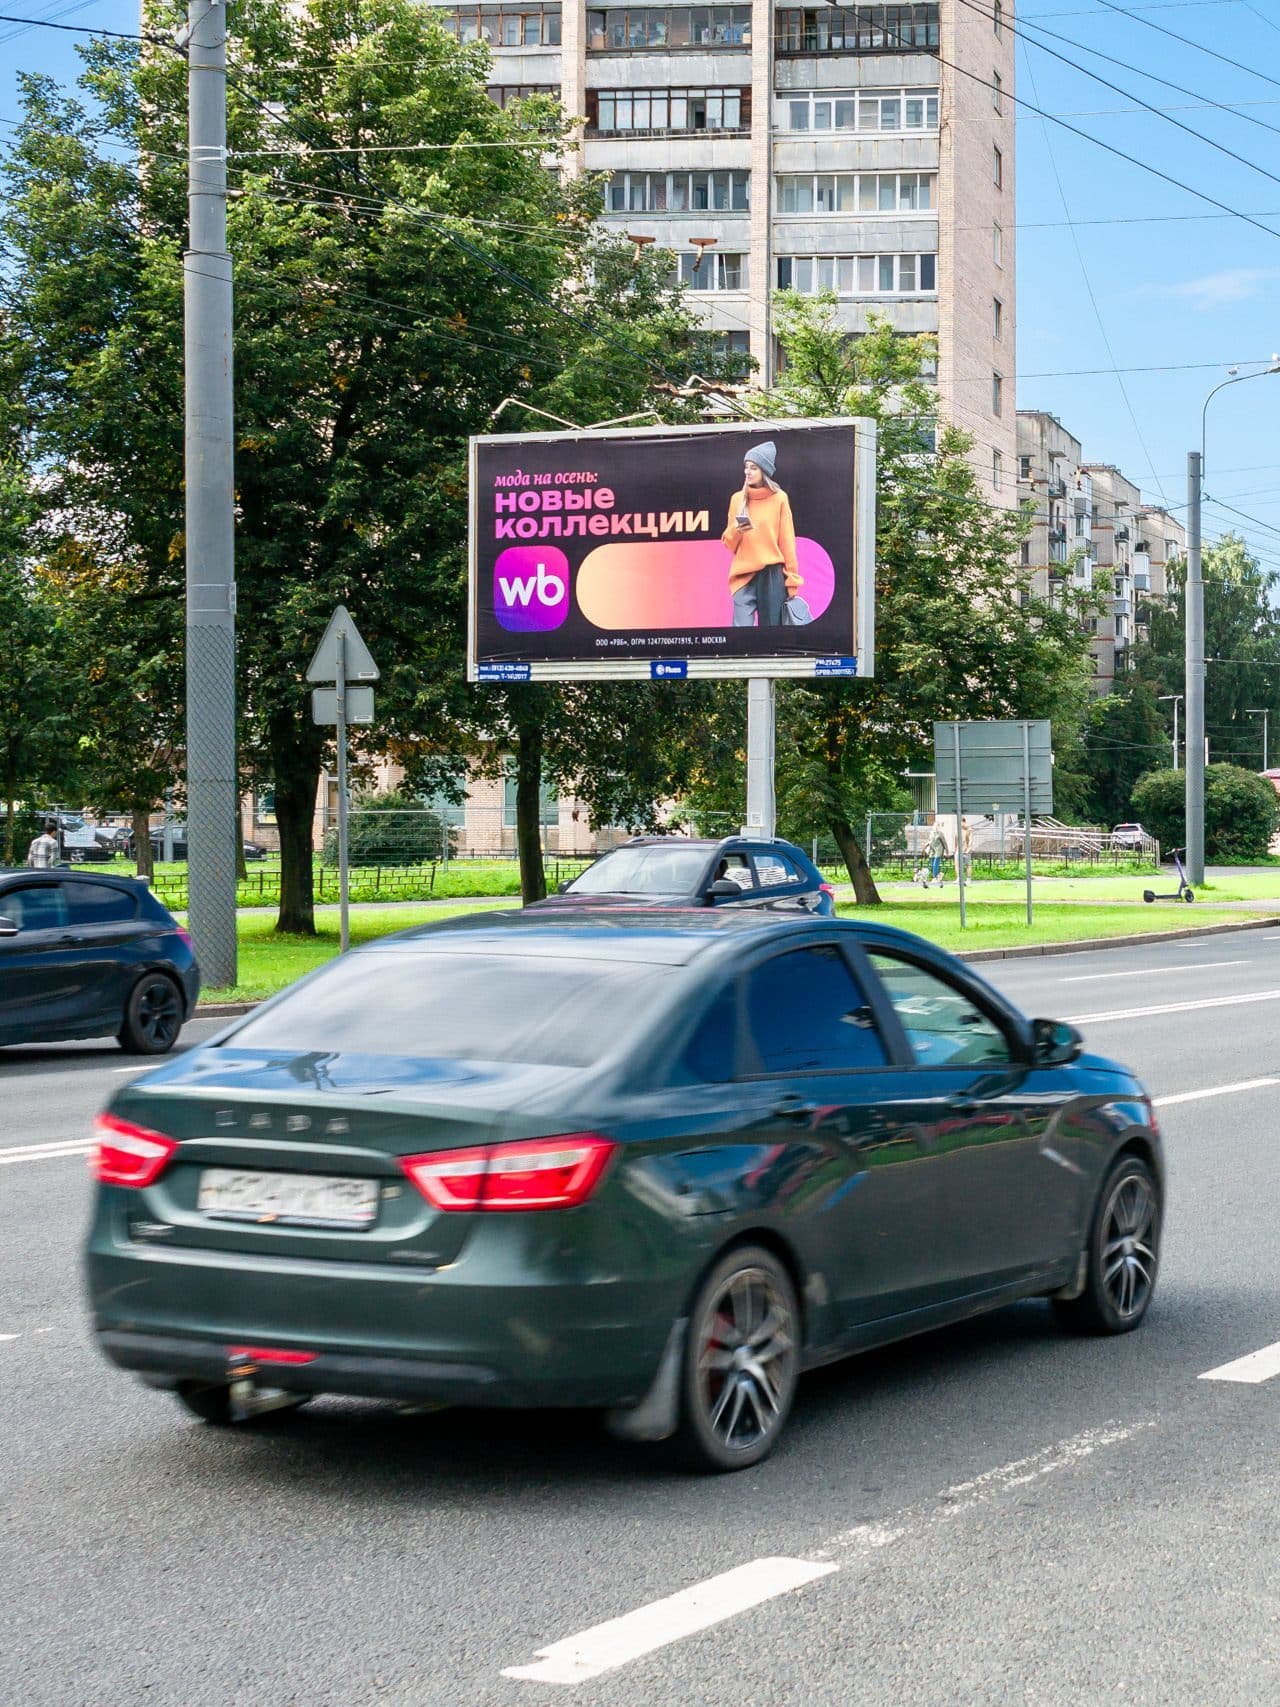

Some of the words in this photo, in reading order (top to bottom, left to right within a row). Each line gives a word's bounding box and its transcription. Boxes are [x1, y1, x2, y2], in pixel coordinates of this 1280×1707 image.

[494, 469, 531, 487] мода
[533, 474, 552, 486] на
[554, 471, 599, 485] осень:
[494, 487, 616, 513] новые
[494, 510, 710, 539] коллекции
[499, 563, 566, 608] wb
[595, 638, 609, 647] ООО
[630, 637, 646, 646] ОГРН
[701, 636, 727, 645] МОСКВА
